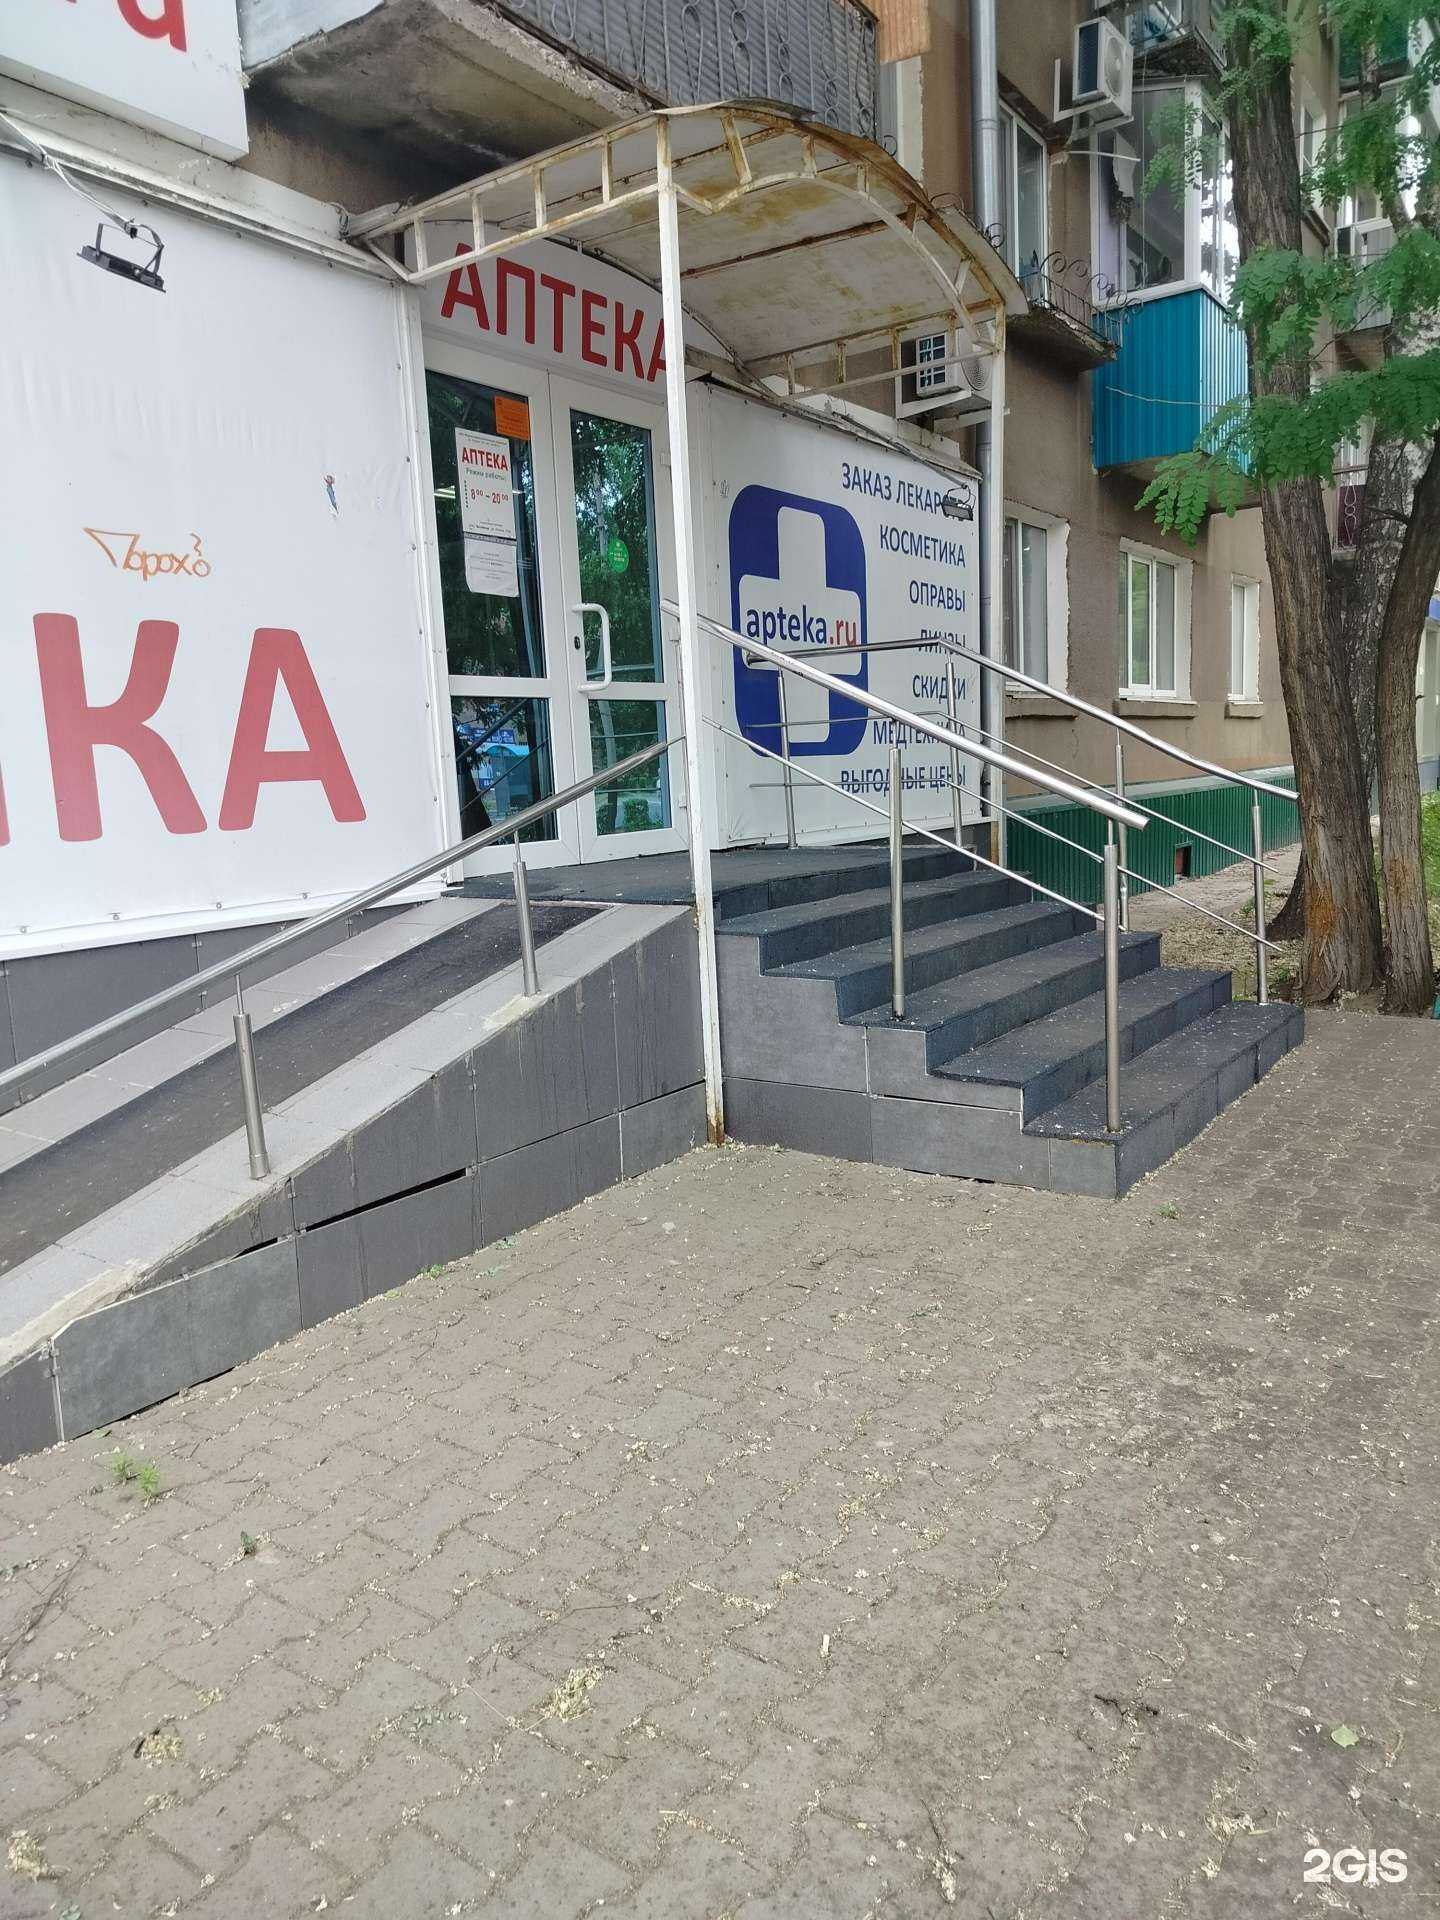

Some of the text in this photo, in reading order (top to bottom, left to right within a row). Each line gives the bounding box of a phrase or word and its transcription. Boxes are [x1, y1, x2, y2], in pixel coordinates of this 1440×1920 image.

[462, 447, 508, 471] АПТЕКА
[842, 462, 965, 521] ЗАКАЗ ЛЕКАР
[880, 524, 966, 568] КОСМЕТИКА
[909, 580, 966, 612] ОПРАВЫ
[746, 604, 857, 647] apteka.ru
[0, 612, 367, 847] КА
